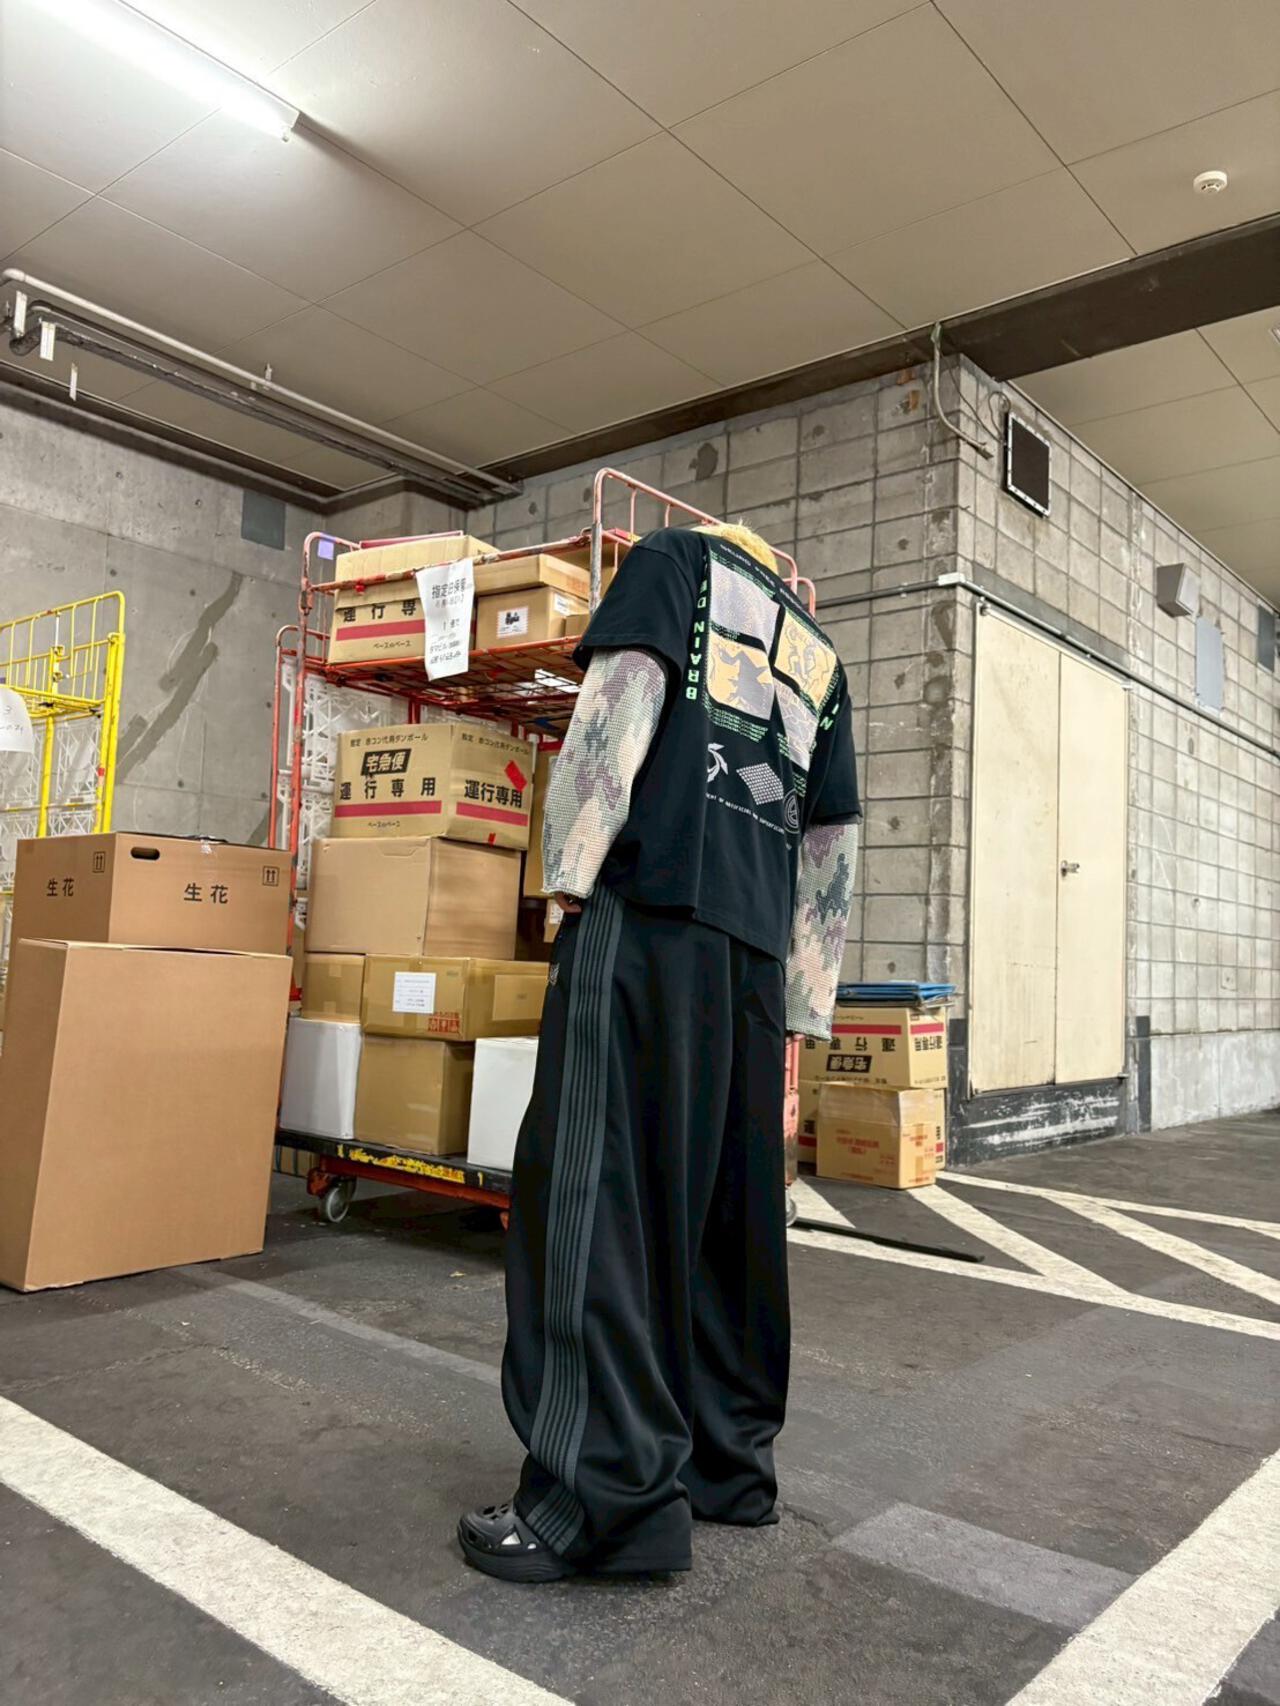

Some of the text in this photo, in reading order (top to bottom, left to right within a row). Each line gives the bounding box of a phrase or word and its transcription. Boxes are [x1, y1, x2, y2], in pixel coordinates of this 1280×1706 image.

[685, 621, 706, 701] BRAIN
[364, 751, 409, 773] 宅急便
[340, 777, 436, 801] 運行専用
[464, 779, 523, 809] 運行専用
[47, 878, 75, 897] 生花
[184, 883, 229, 904] 生花
